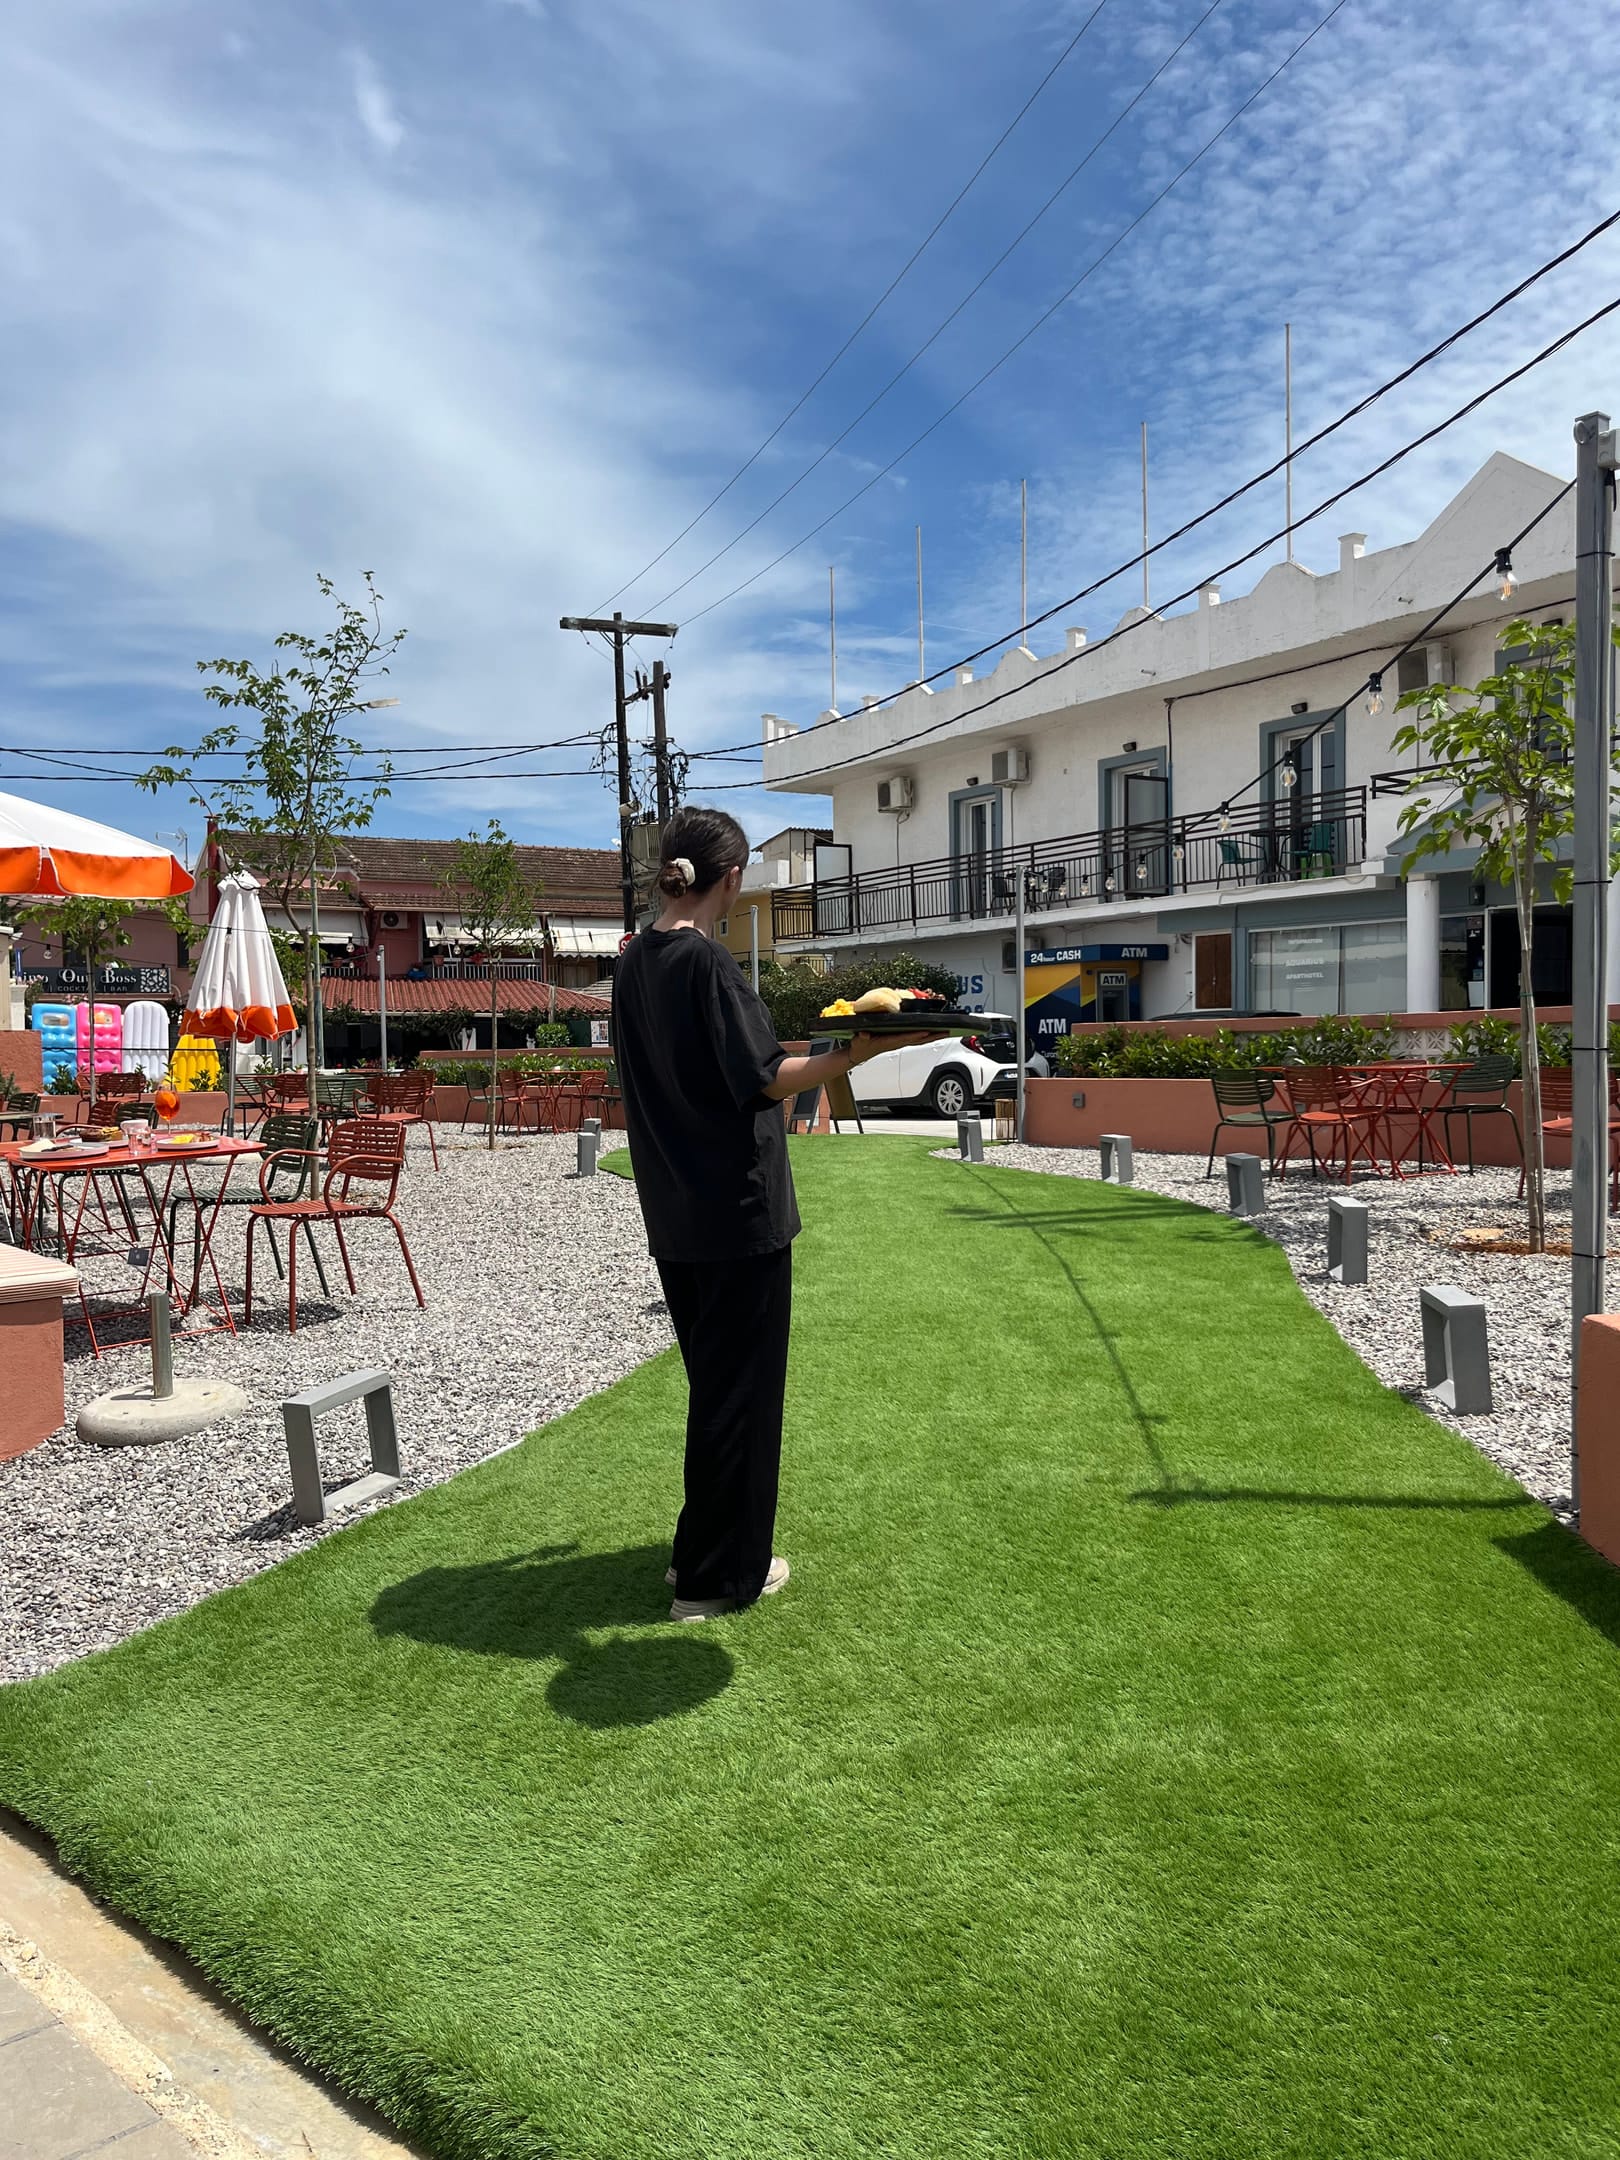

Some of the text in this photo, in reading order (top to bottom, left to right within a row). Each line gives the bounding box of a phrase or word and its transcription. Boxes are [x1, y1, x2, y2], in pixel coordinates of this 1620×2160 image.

[1056, 949, 1081, 961] CASH
[1121, 947, 1148, 958] ATM
[101, 969, 137, 983] Boss
[1102, 975, 1125, 985] ATM
[1038, 1018, 1067, 1034] ATM
